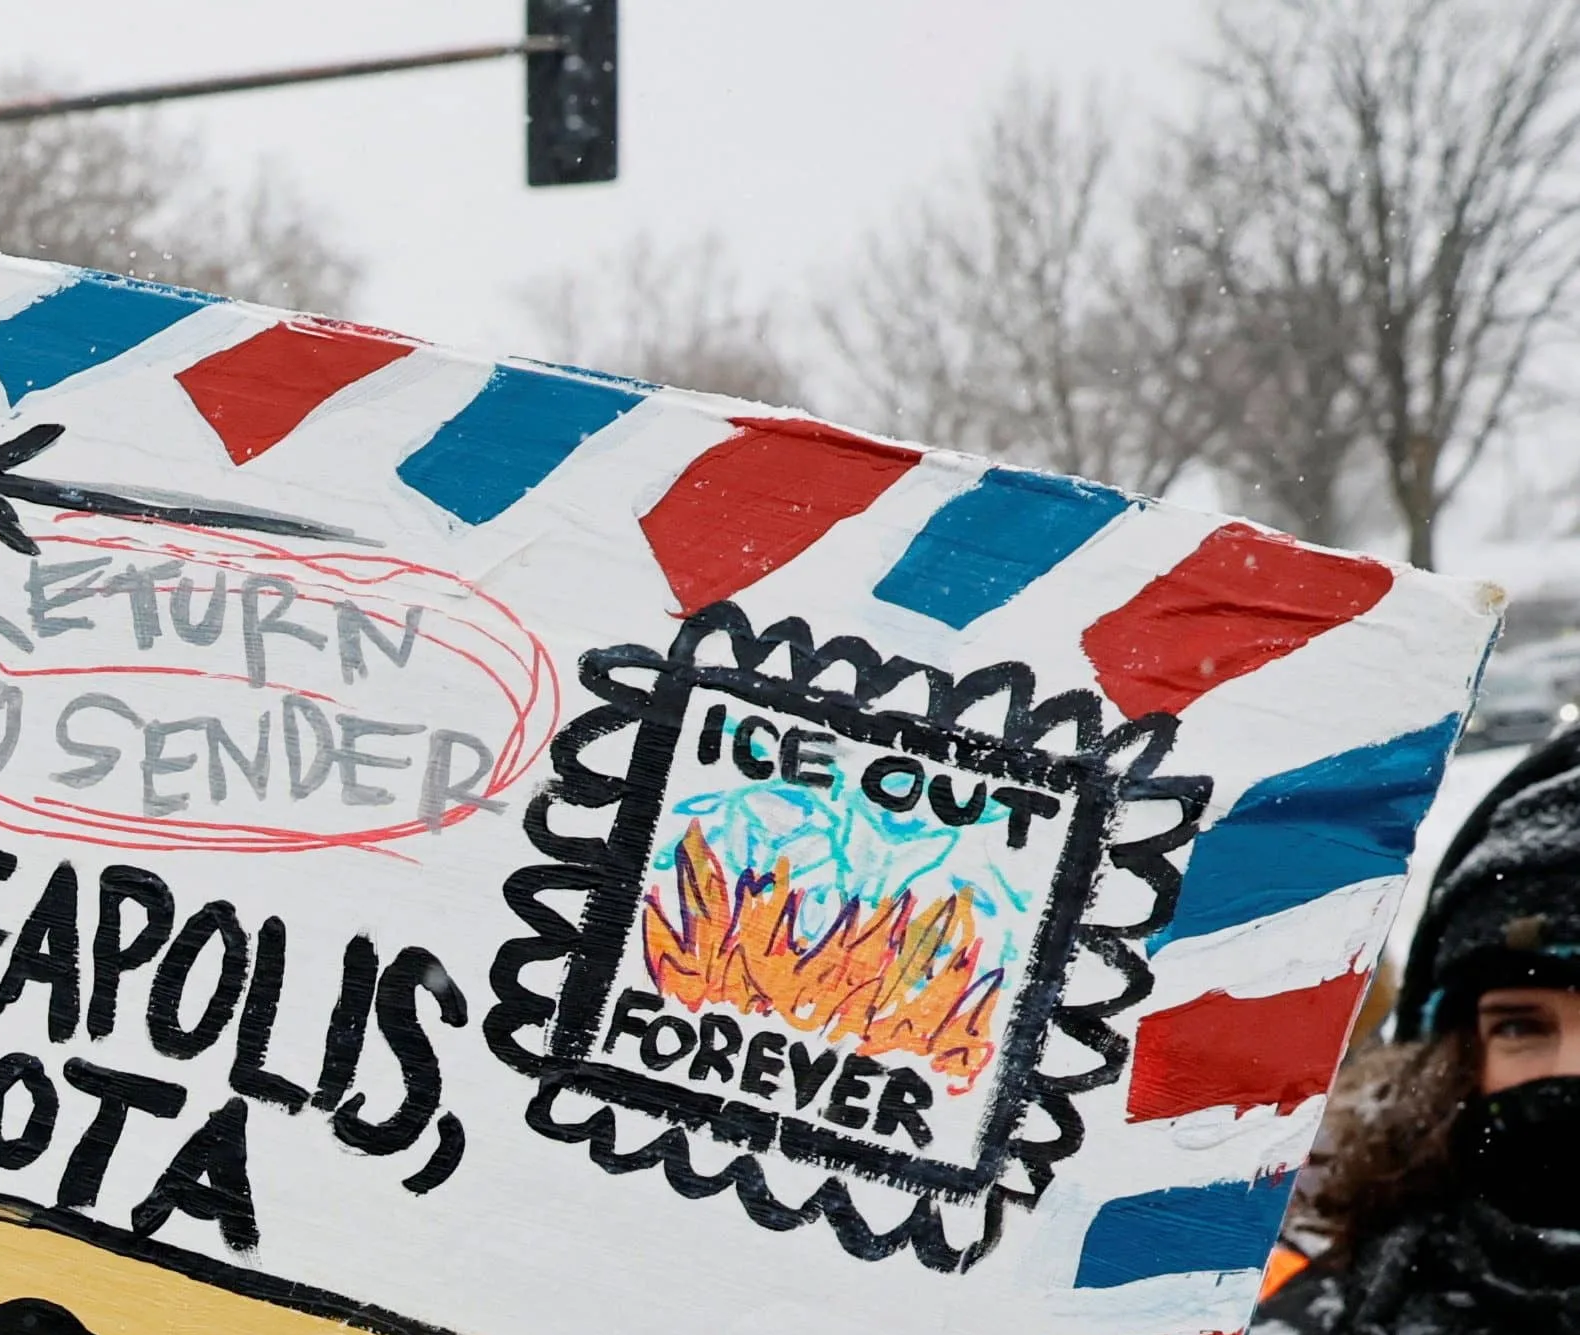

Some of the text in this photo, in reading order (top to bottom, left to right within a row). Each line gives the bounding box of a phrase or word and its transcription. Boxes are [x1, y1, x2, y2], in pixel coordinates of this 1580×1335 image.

[49, 692, 509, 834] SENDER
[696, 705, 1060, 848] ICE OUT
[601, 989, 933, 1151] FOREVER
